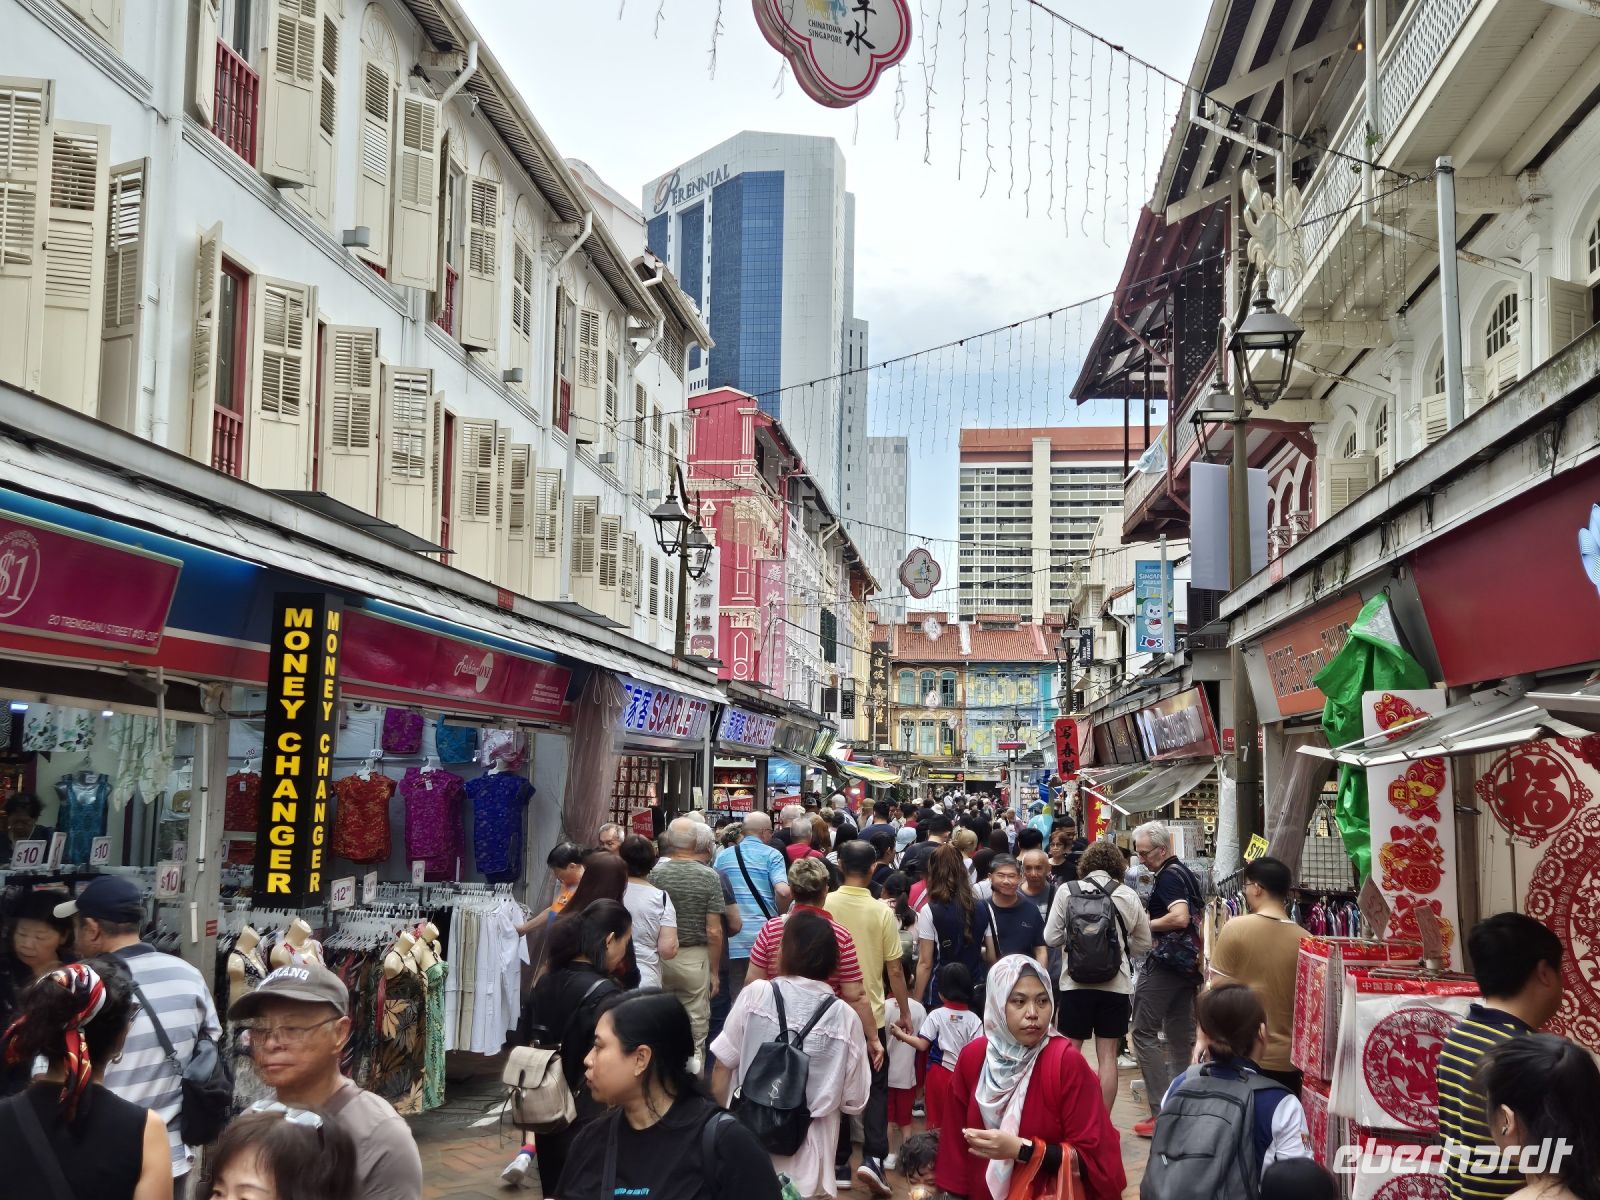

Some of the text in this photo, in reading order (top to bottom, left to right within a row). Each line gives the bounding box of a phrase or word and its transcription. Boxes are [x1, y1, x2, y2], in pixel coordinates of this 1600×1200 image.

[808, 19, 843, 35] CHINATOWN
[808, 28, 842, 44] SINGAPORE
[48, 614, 60, 625] 20
[60, 616, 105, 633] TRENGGANU
[105, 624, 133, 637] STREET
[648, 690, 707, 737] SCARLETT
[743, 714, 777, 745] SCARLETT
[266, 607, 313, 894] MONEY CHANGER
[309, 609, 340, 893] MONEY CHANGER
[1240, 745, 1249, 762] 7
[16, 846, 39, 864] $10
[94, 842, 108, 859] $10
[160, 868, 178, 891] $10
